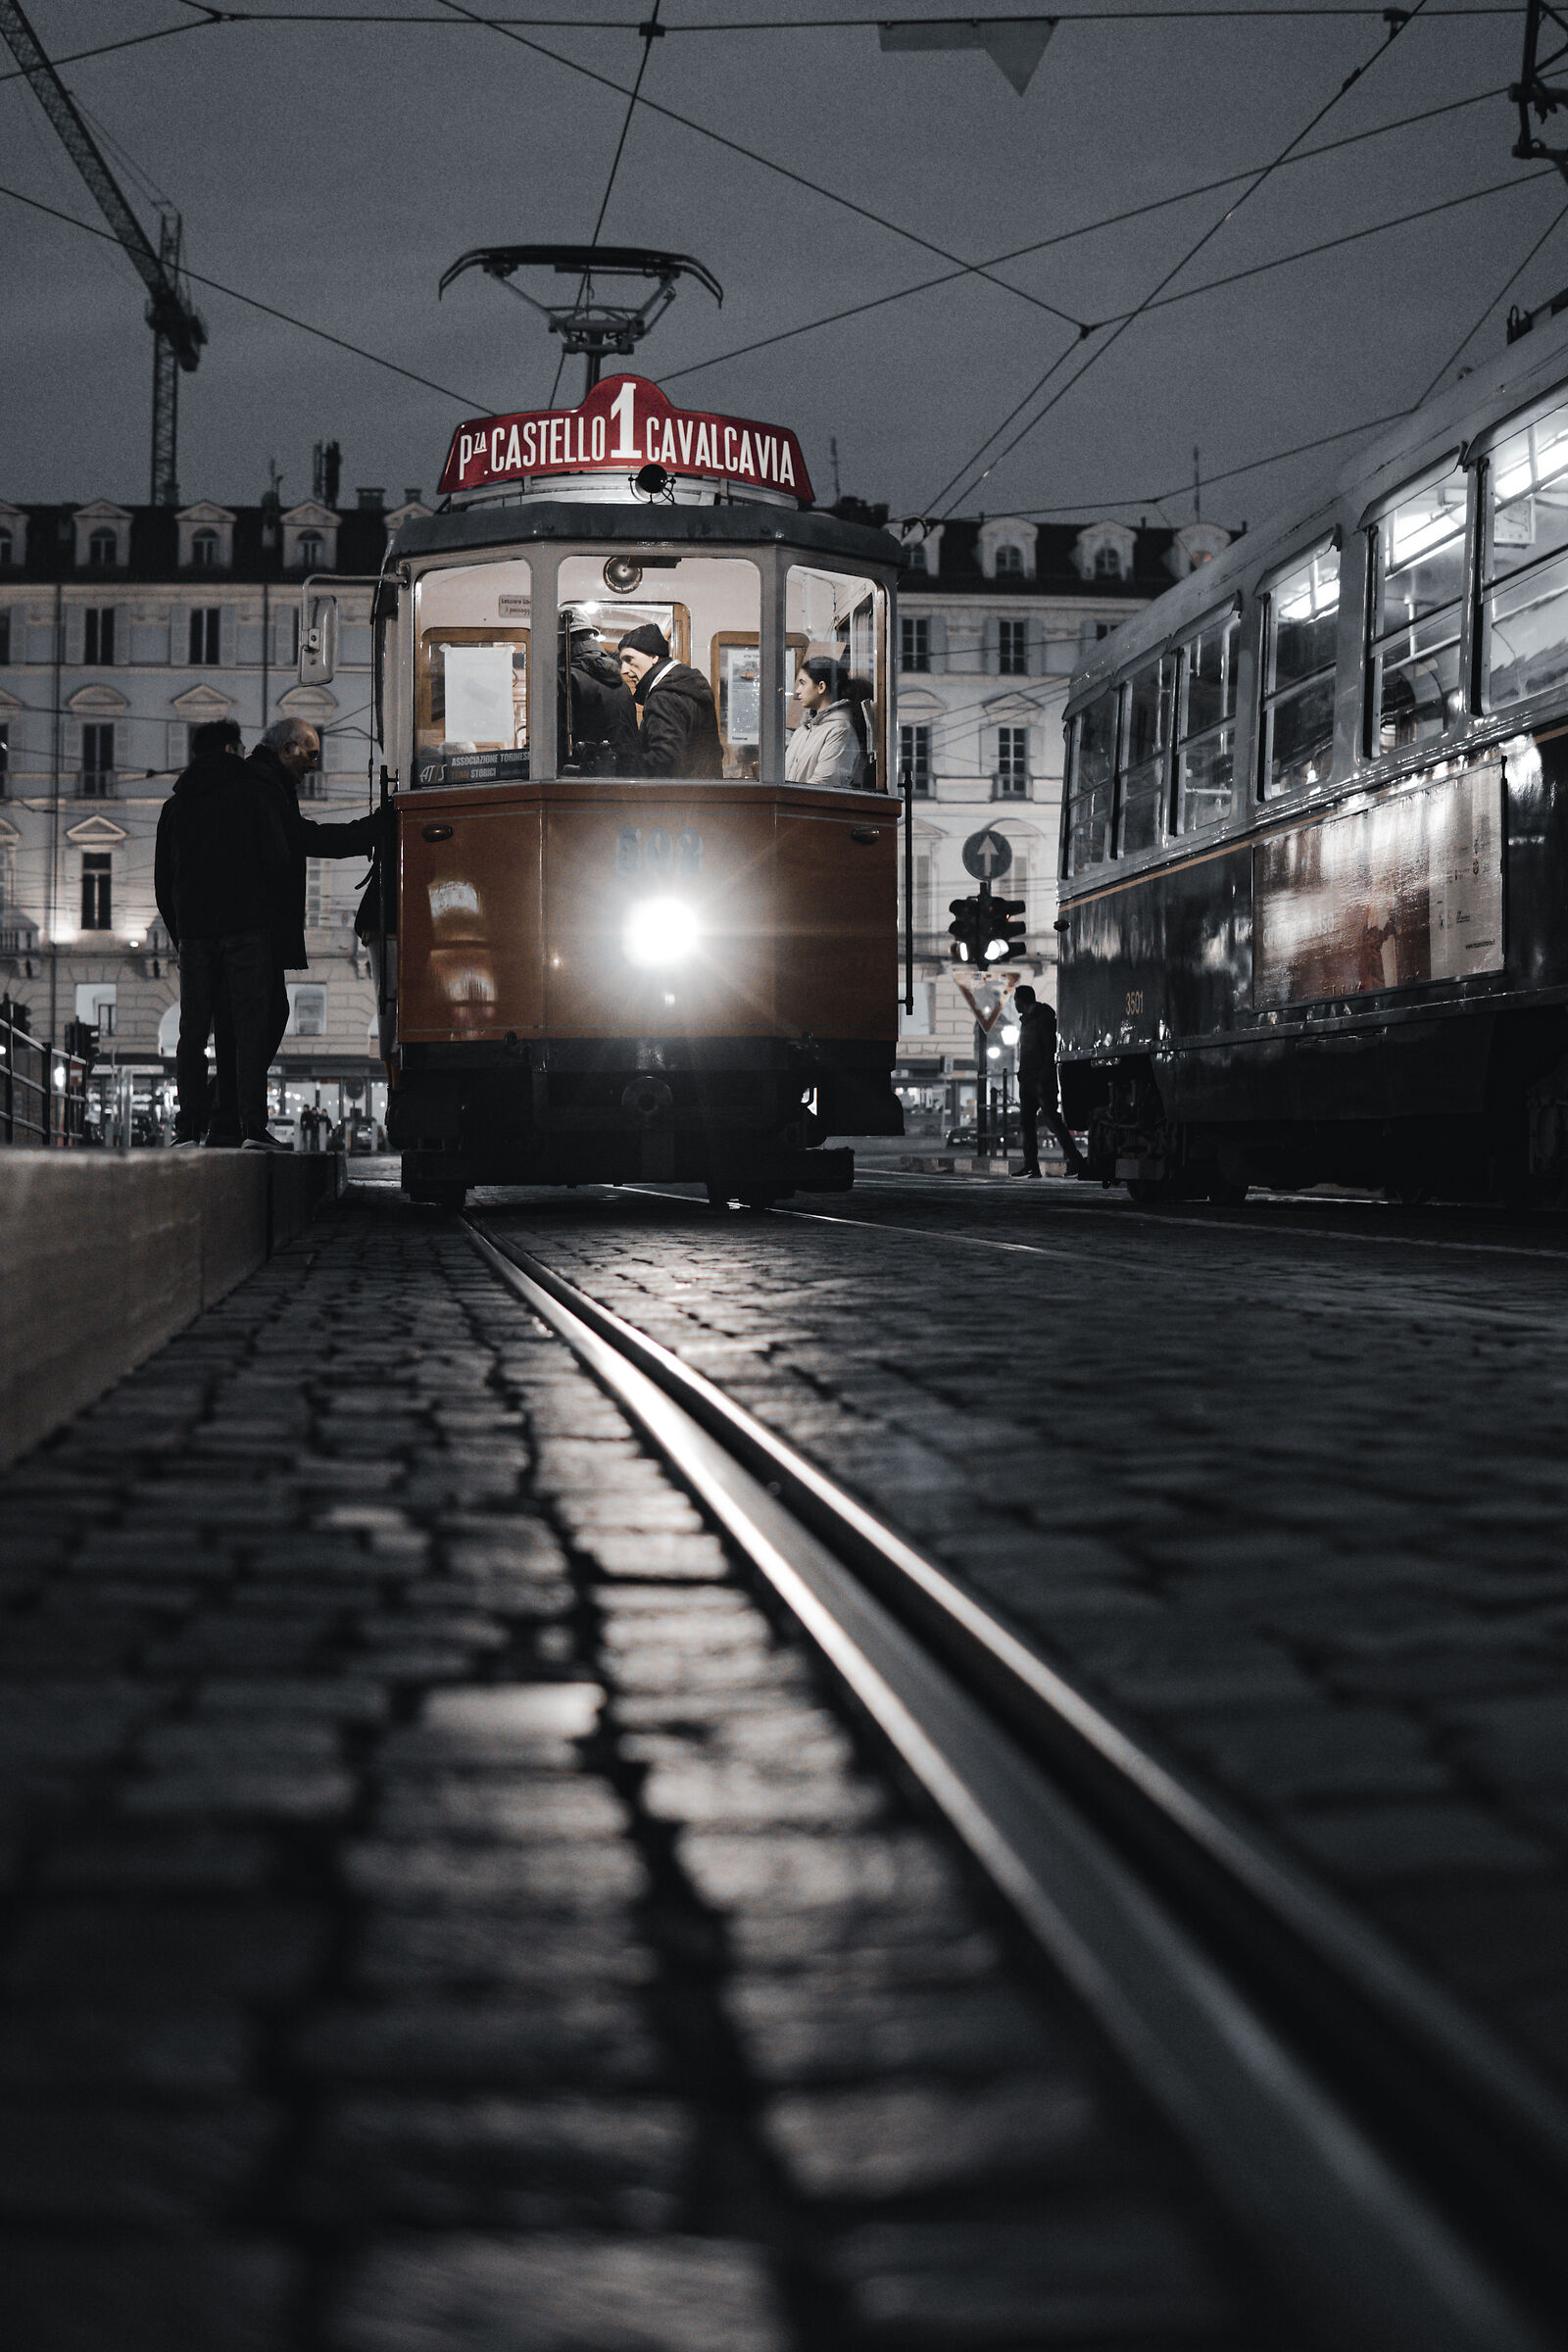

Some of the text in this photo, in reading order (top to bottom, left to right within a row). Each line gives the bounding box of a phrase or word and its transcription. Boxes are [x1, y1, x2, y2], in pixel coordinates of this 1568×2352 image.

[491, 416, 606, 472] CASTELLO
[611, 381, 643, 459] 1
[646, 416, 796, 487] CAVALCAVIA
[452, 755, 498, 766] ASSOCIAZIONE
[1125, 990, 1144, 1016] 3501
